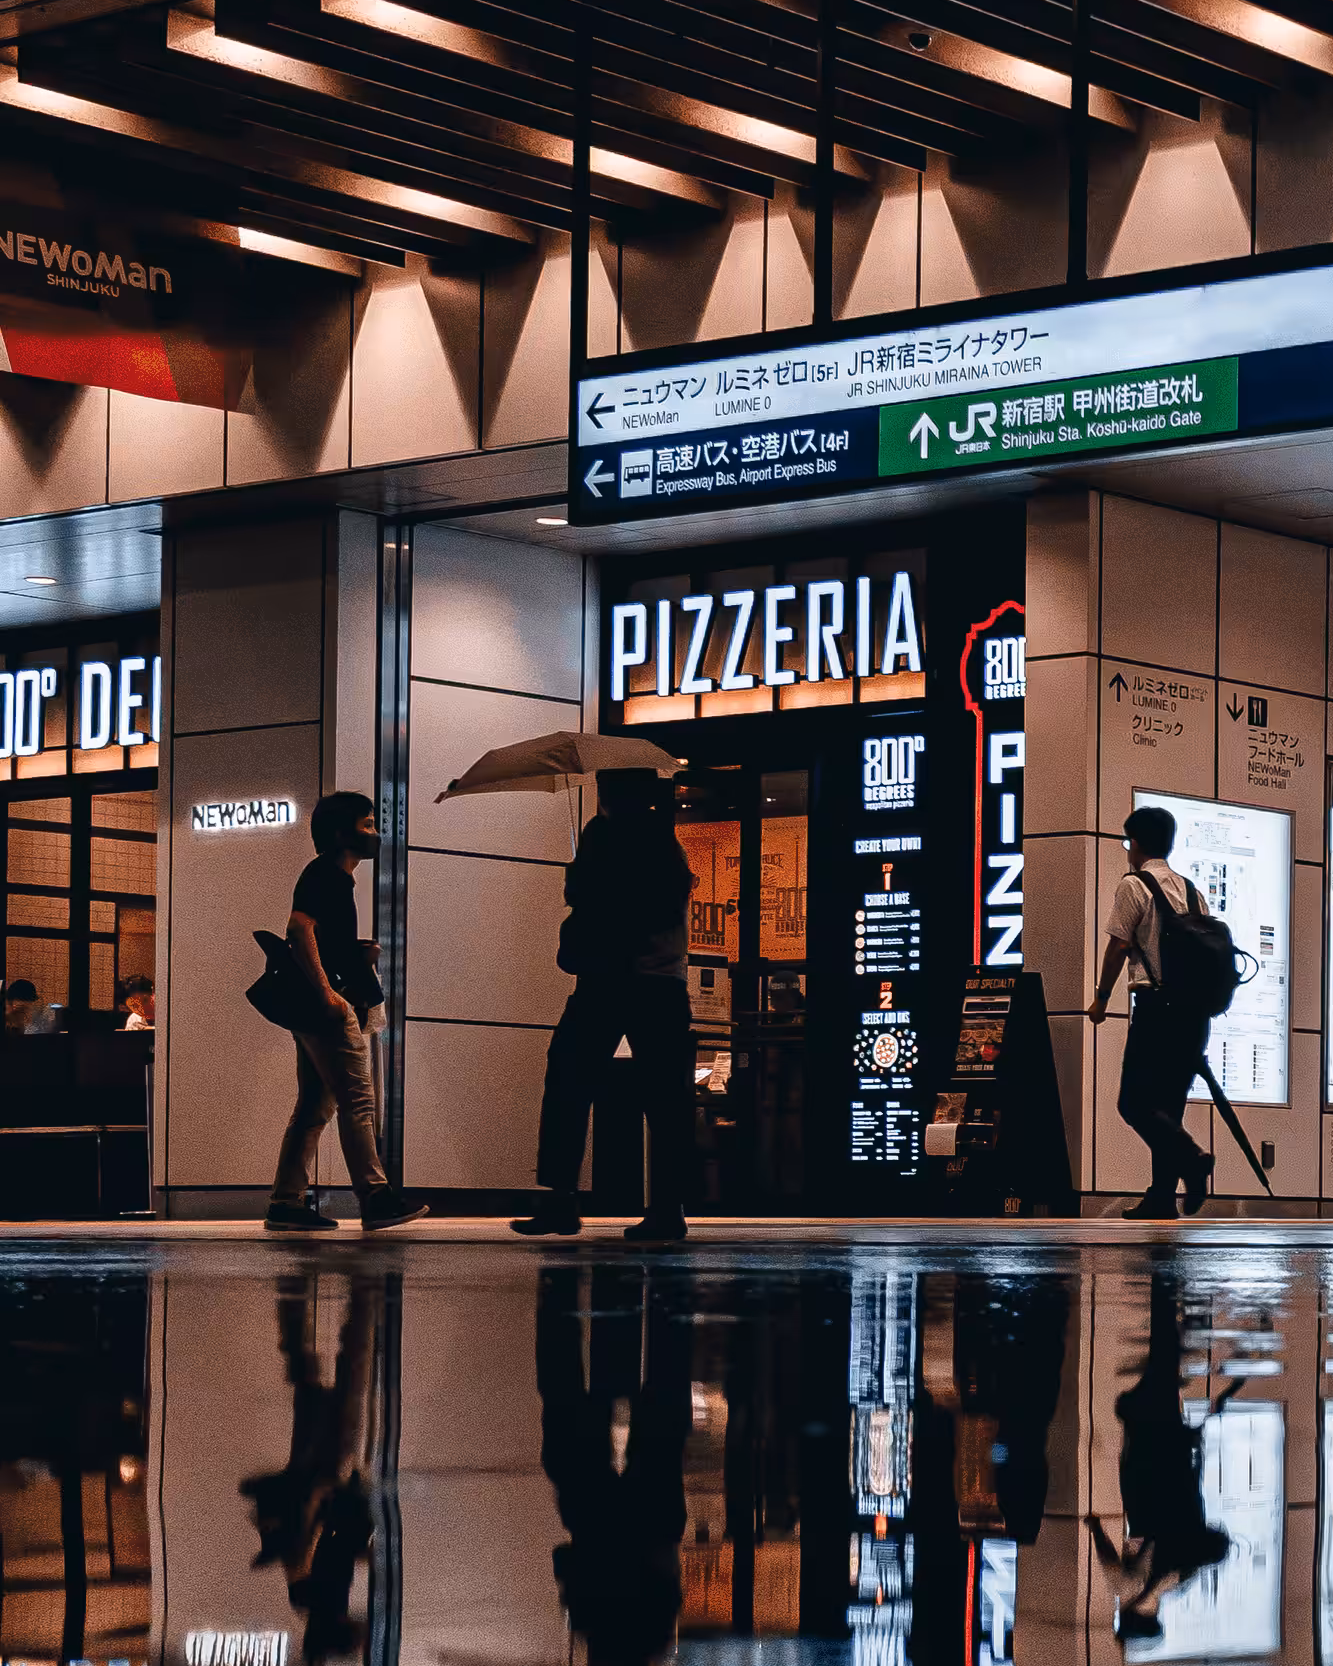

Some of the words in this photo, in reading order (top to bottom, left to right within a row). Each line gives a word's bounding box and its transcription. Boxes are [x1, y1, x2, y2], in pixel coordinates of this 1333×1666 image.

[46, 273, 120, 298] SHINJUKU
[847, 327, 1049, 377] JR新宿ミライナタワー
[622, 377, 707, 407] ニュウマン
[715, 365, 769, 396] ルミネ
[847, 382, 863, 398] JR
[866, 373, 931, 394] SHINJUKU
[935, 364, 990, 385] MIRAINA
[991, 356, 1042, 377] TOWER
[622, 410, 680, 430] NEWoMan
[715, 398, 760, 416] LUMINE
[764, 397, 772, 410] 0
[1001, 393, 1066, 428] 新宿駅
[1072, 374, 1203, 420] 甲州街道改札
[1001, 429, 1055, 451] Shinjuku
[1058, 426, 1083, 442] Sta.
[1086, 413, 1166, 438] Kōshū-kaidō
[1170, 410, 1201, 428] Gate
[955, 441, 991, 455] JR東日本
[656, 470, 713, 495] Expressway
[715, 468, 738, 486] Bus,
[739, 465, 772, 485] Airport
[774, 461, 814, 481] Express
[816, 458, 837, 473] Bus
[611, 571, 922, 701] PIZZERIA
[1132, 675, 1189, 700] ルミネゼロ
[1132, 695, 1169, 712] LUMINE
[1132, 715, 1184, 737] クリニック
[1248, 728, 1299, 749] ニュウマン
[1132, 733, 1157, 748] Clinic
[1248, 745, 1304, 768] フードホール
[1248, 761, 1291, 778] NEWoMan
[1248, 774, 1268, 787] Food
[1271, 777, 1287, 789] Hall
[864, 784, 915, 801] DEGREES
[191, 799, 291, 830] NEWoMan
[880, 991, 892, 1009] 2
